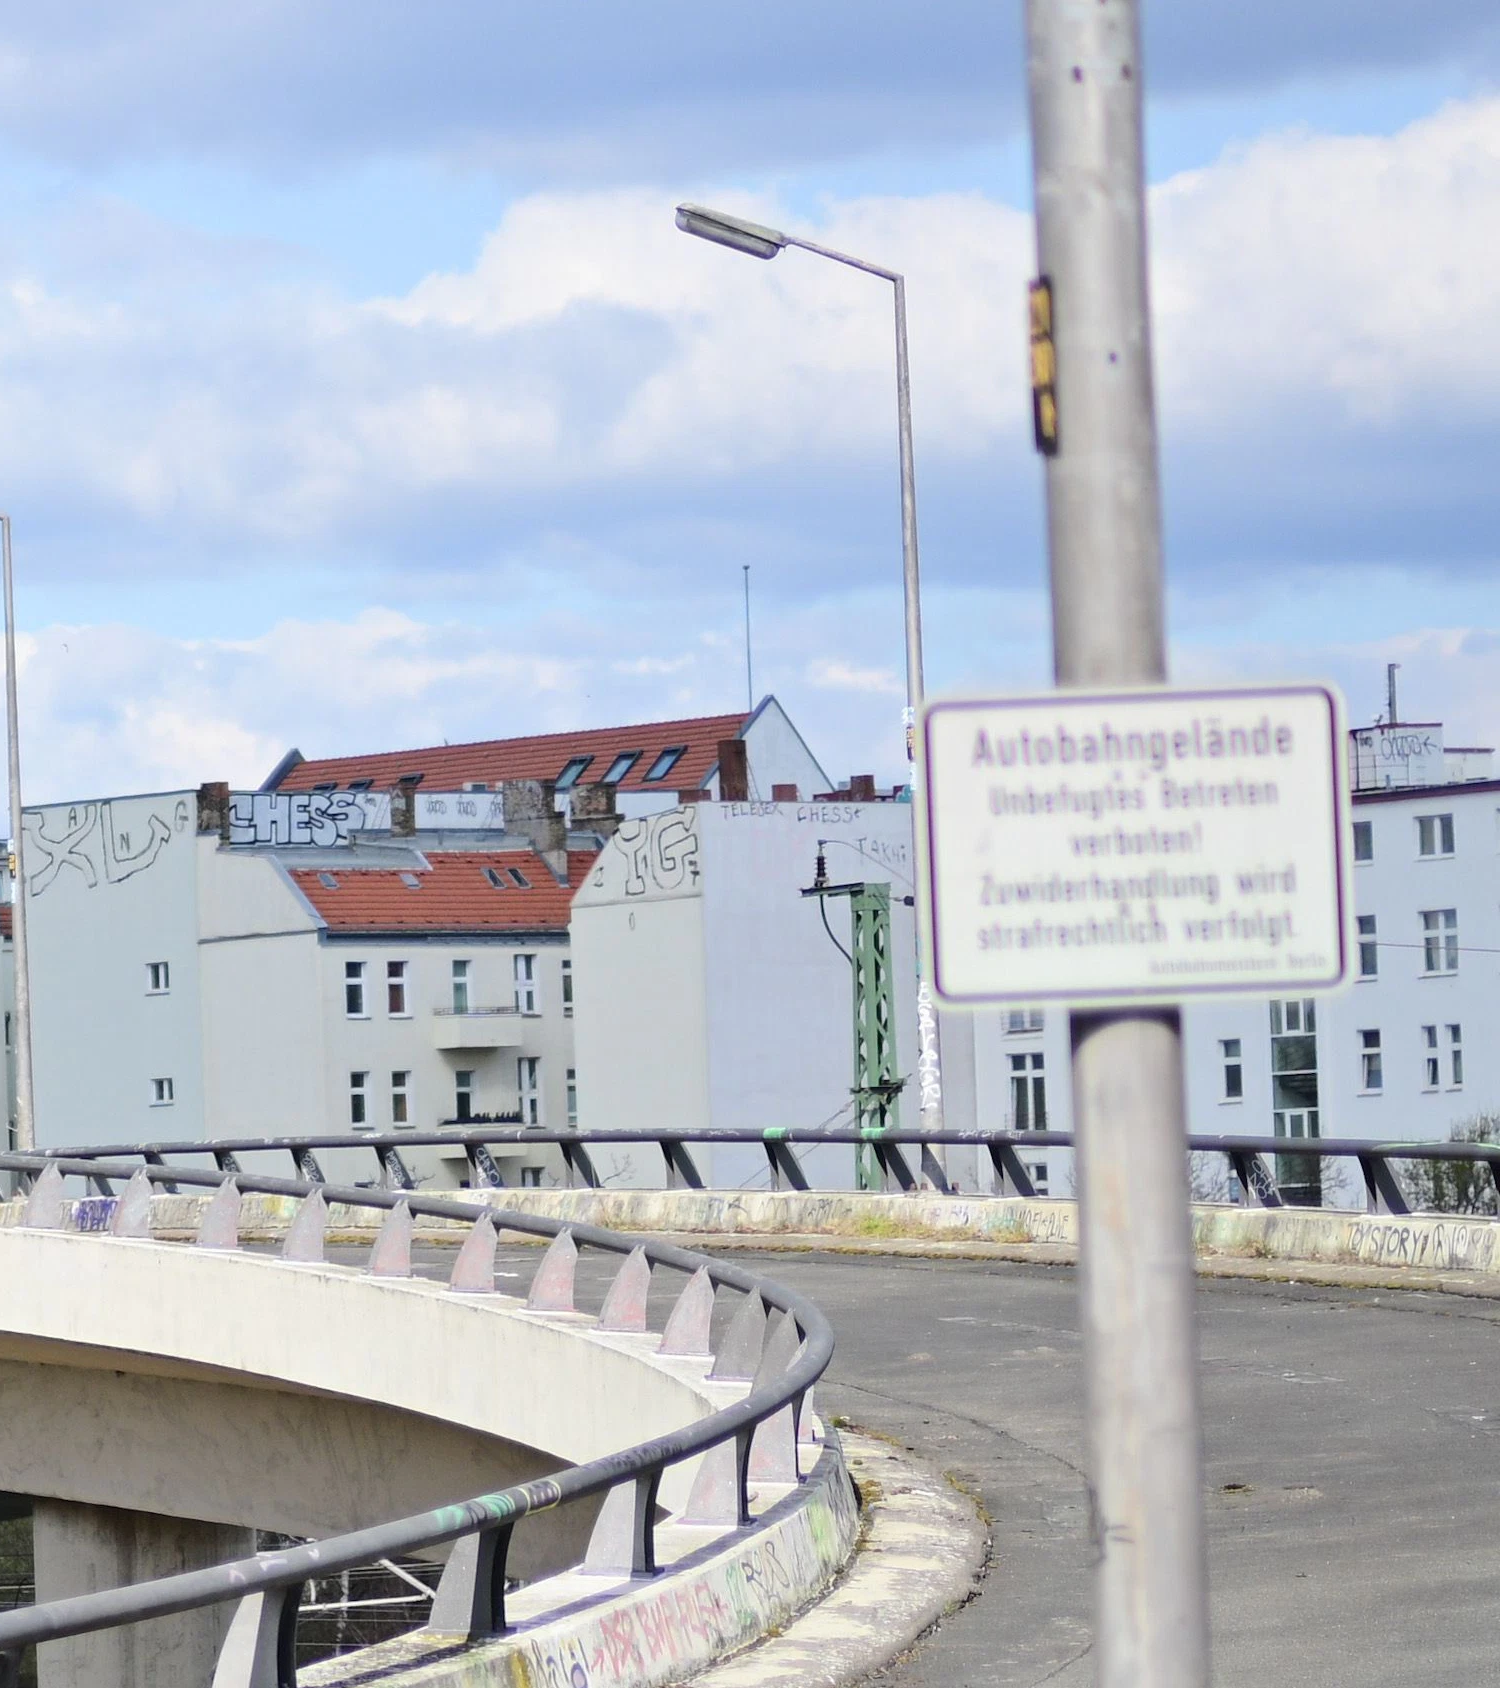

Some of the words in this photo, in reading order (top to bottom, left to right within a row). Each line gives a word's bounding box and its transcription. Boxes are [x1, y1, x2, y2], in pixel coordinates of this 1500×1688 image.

[972, 716, 1296, 770] Autobahngelände
[988, 785, 1146, 819] Unbefugtes
[1160, 776, 1280, 809] Betreten
[1068, 823, 1203, 857] verboten!
[979, 870, 1221, 906] Zuwiderhandlung
[1235, 863, 1297, 895] wird
[977, 912, 1169, 952] strafrechtlich
